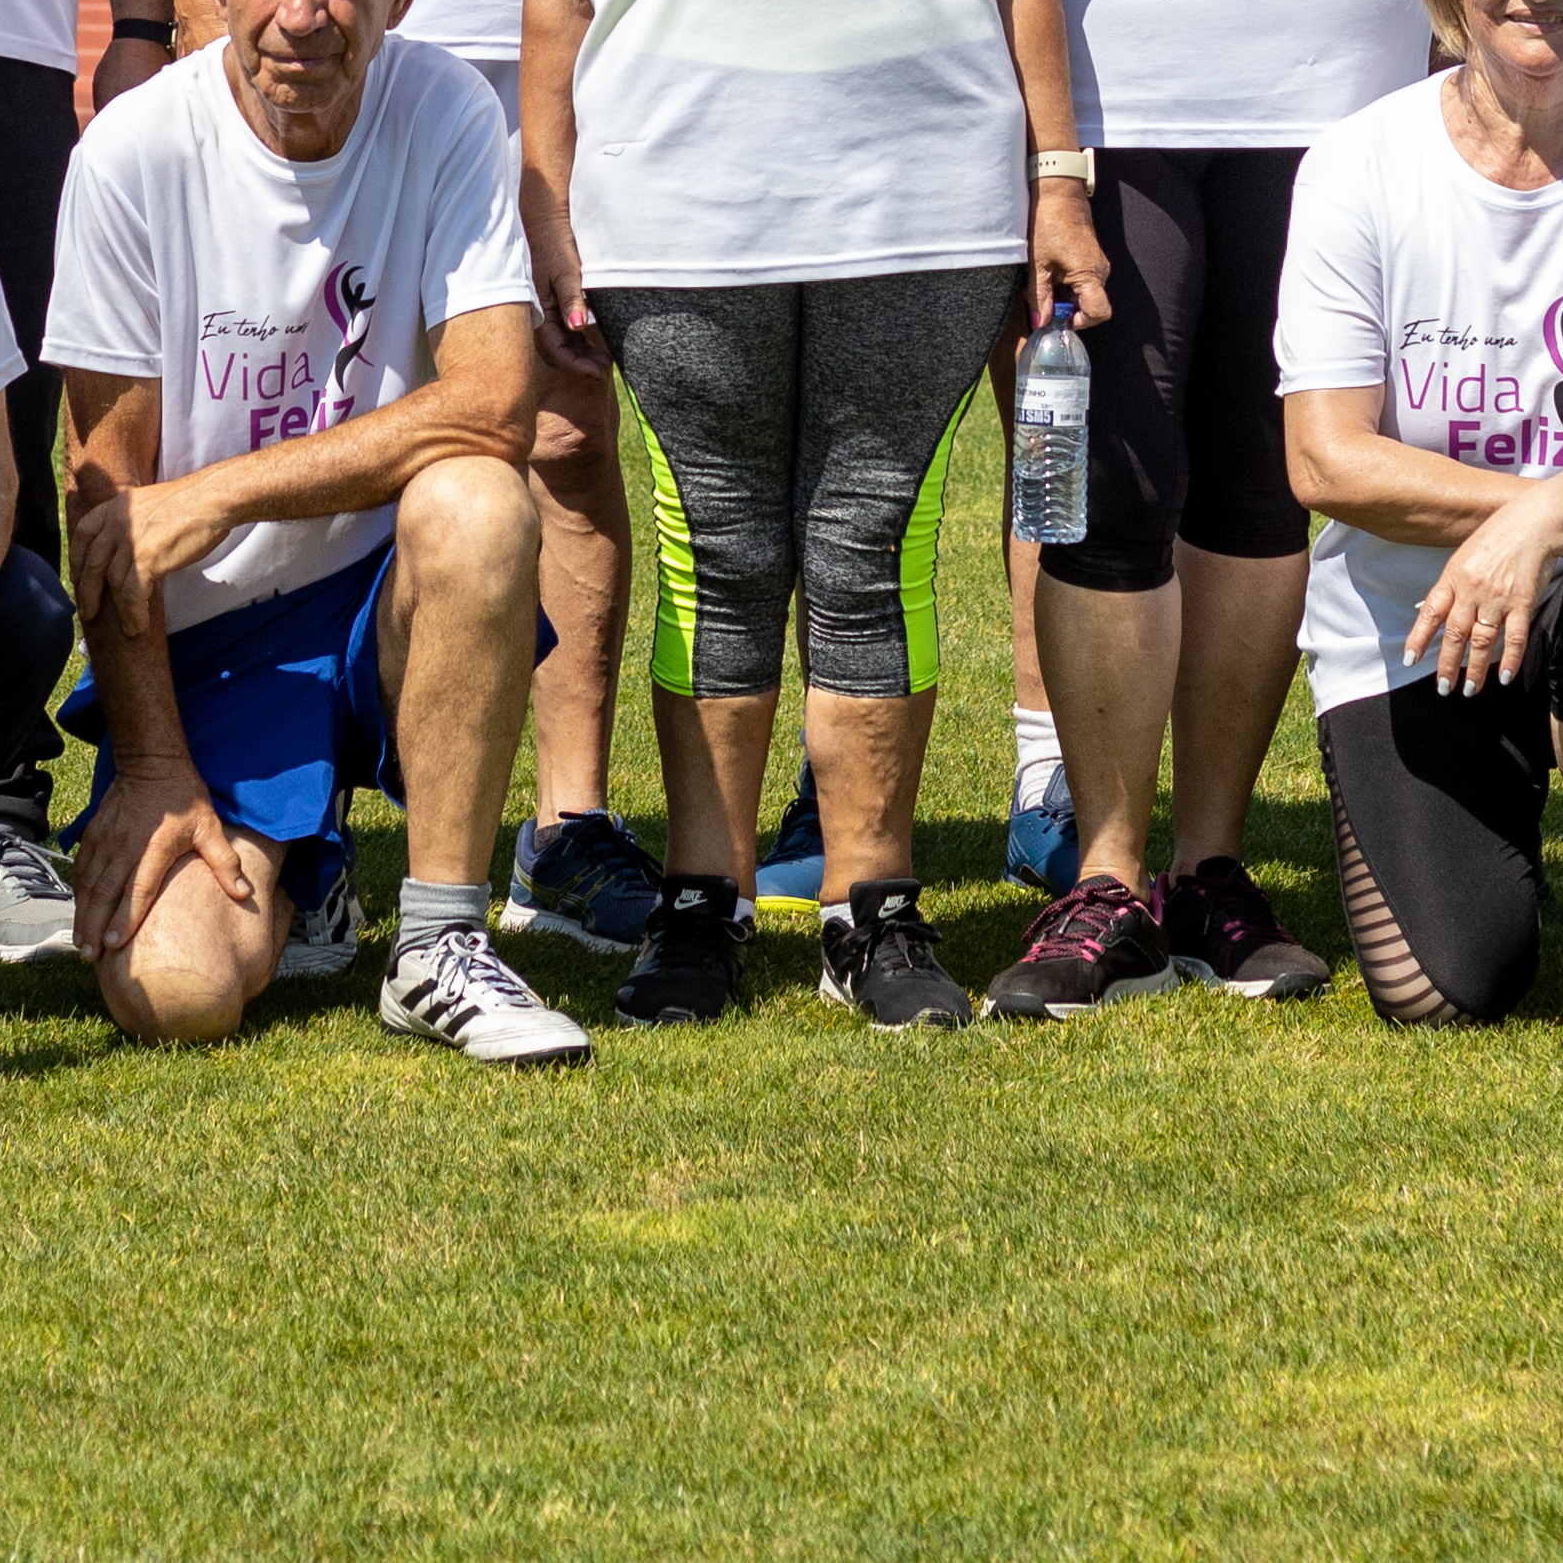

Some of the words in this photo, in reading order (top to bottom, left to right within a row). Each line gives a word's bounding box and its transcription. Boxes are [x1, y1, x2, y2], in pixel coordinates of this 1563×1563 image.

[200, 310, 236, 341] Eu
[233, 314, 279, 341] tenho
[1400, 318, 1440, 350] Eu
[1436, 325, 1479, 350] tenho
[1485, 335, 1518, 348] uma
[201, 349, 315, 401] Vida
[1401, 358, 1524, 413] Vida
[679, 888, 703, 902] NIKE
[884, 895, 905, 909] NIKE
